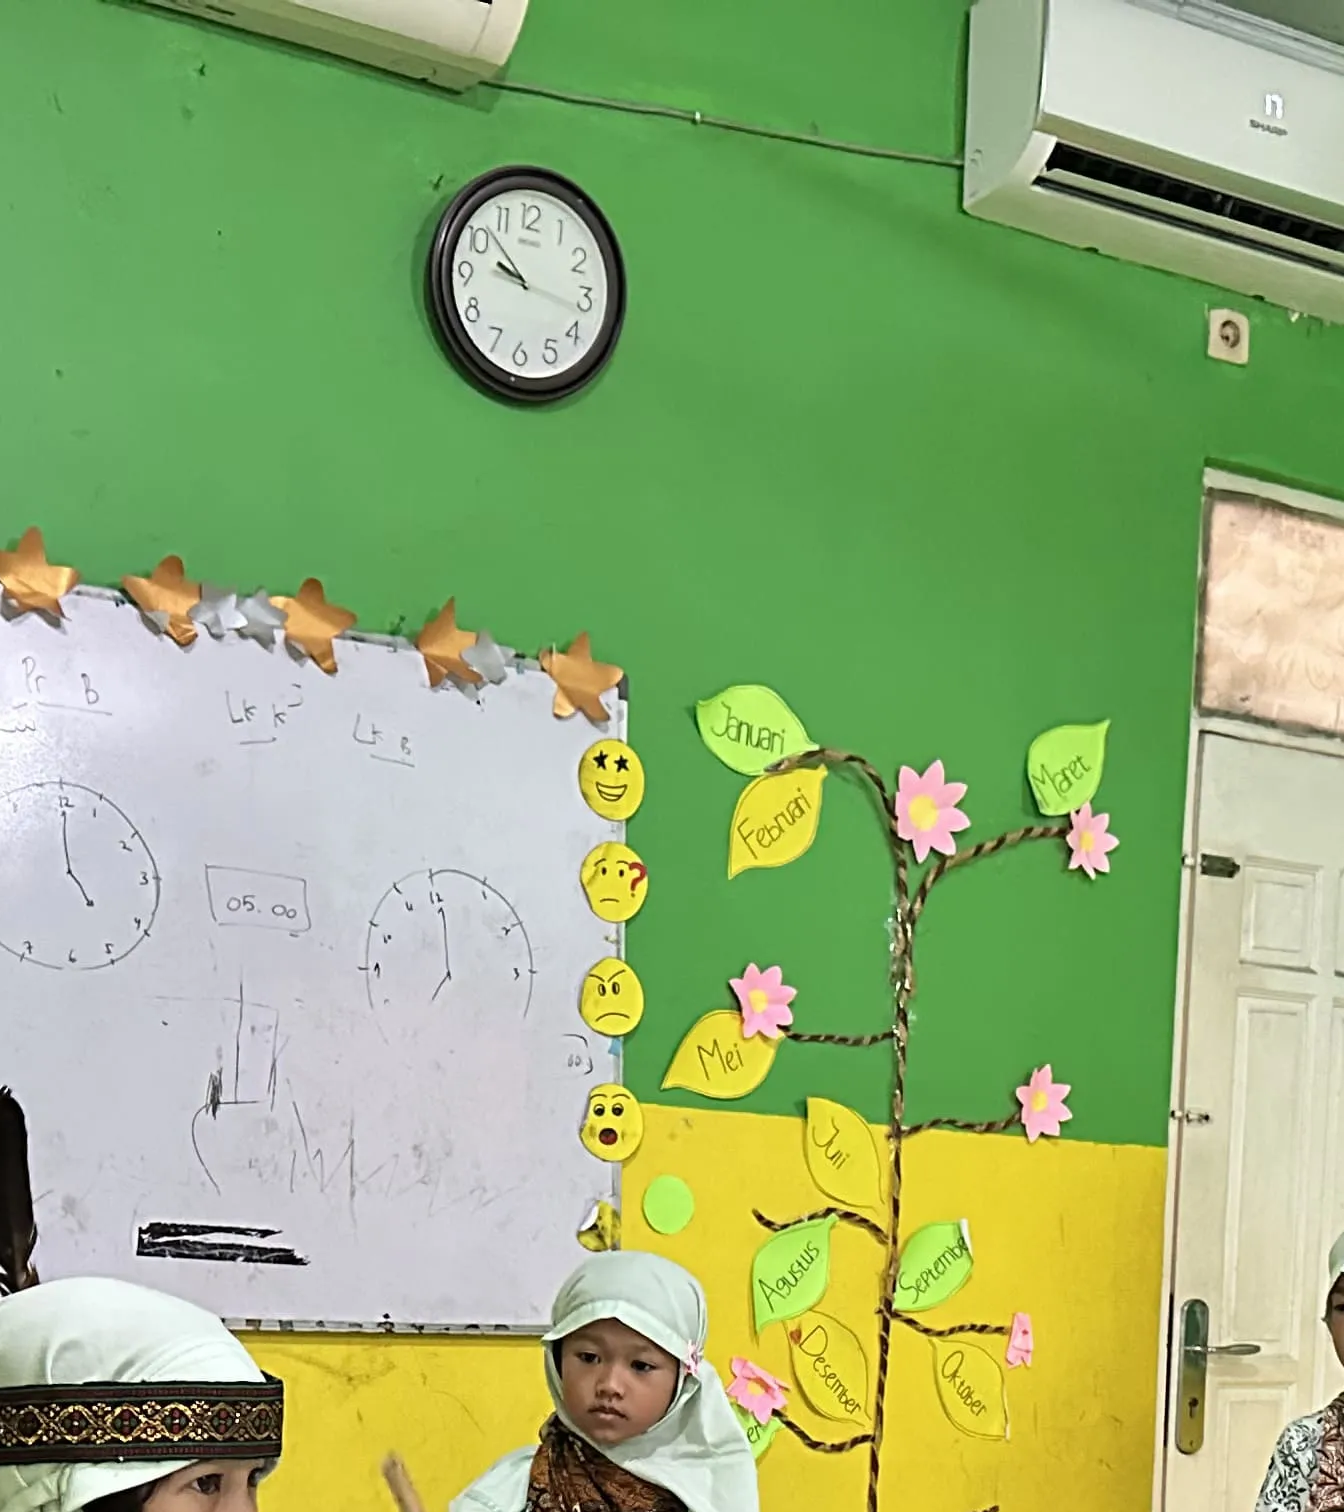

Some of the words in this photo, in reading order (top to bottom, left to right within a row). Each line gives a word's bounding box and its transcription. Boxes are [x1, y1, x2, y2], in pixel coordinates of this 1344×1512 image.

[496, 205, 510, 234] 11
[521, 202, 542, 232] 12
[468, 225, 490, 254] 10
[557, 219, 563, 245] 1
[458, 261, 474, 287] 9
[571, 247, 587, 274] 2
[464, 297, 480, 322] 8
[577, 285, 593, 312] 3
[489, 326, 503, 352] 7
[565, 321, 581, 345] 4
[512, 341, 528, 367] 6
[542, 338, 558, 364] 5
[710, 700, 787, 756] Januari
[1031, 755, 1092, 803] Maret
[736, 787, 813, 860] Februari
[697, 1040, 744, 1081] Mei
[812, 1116, 850, 1170] Juli
[758, 1240, 820, 1313] Agustus
[899, 1235, 969, 1305] Septembe
[799, 1325, 862, 1415] Desember
[941, 1350, 987, 1418] Oktober
